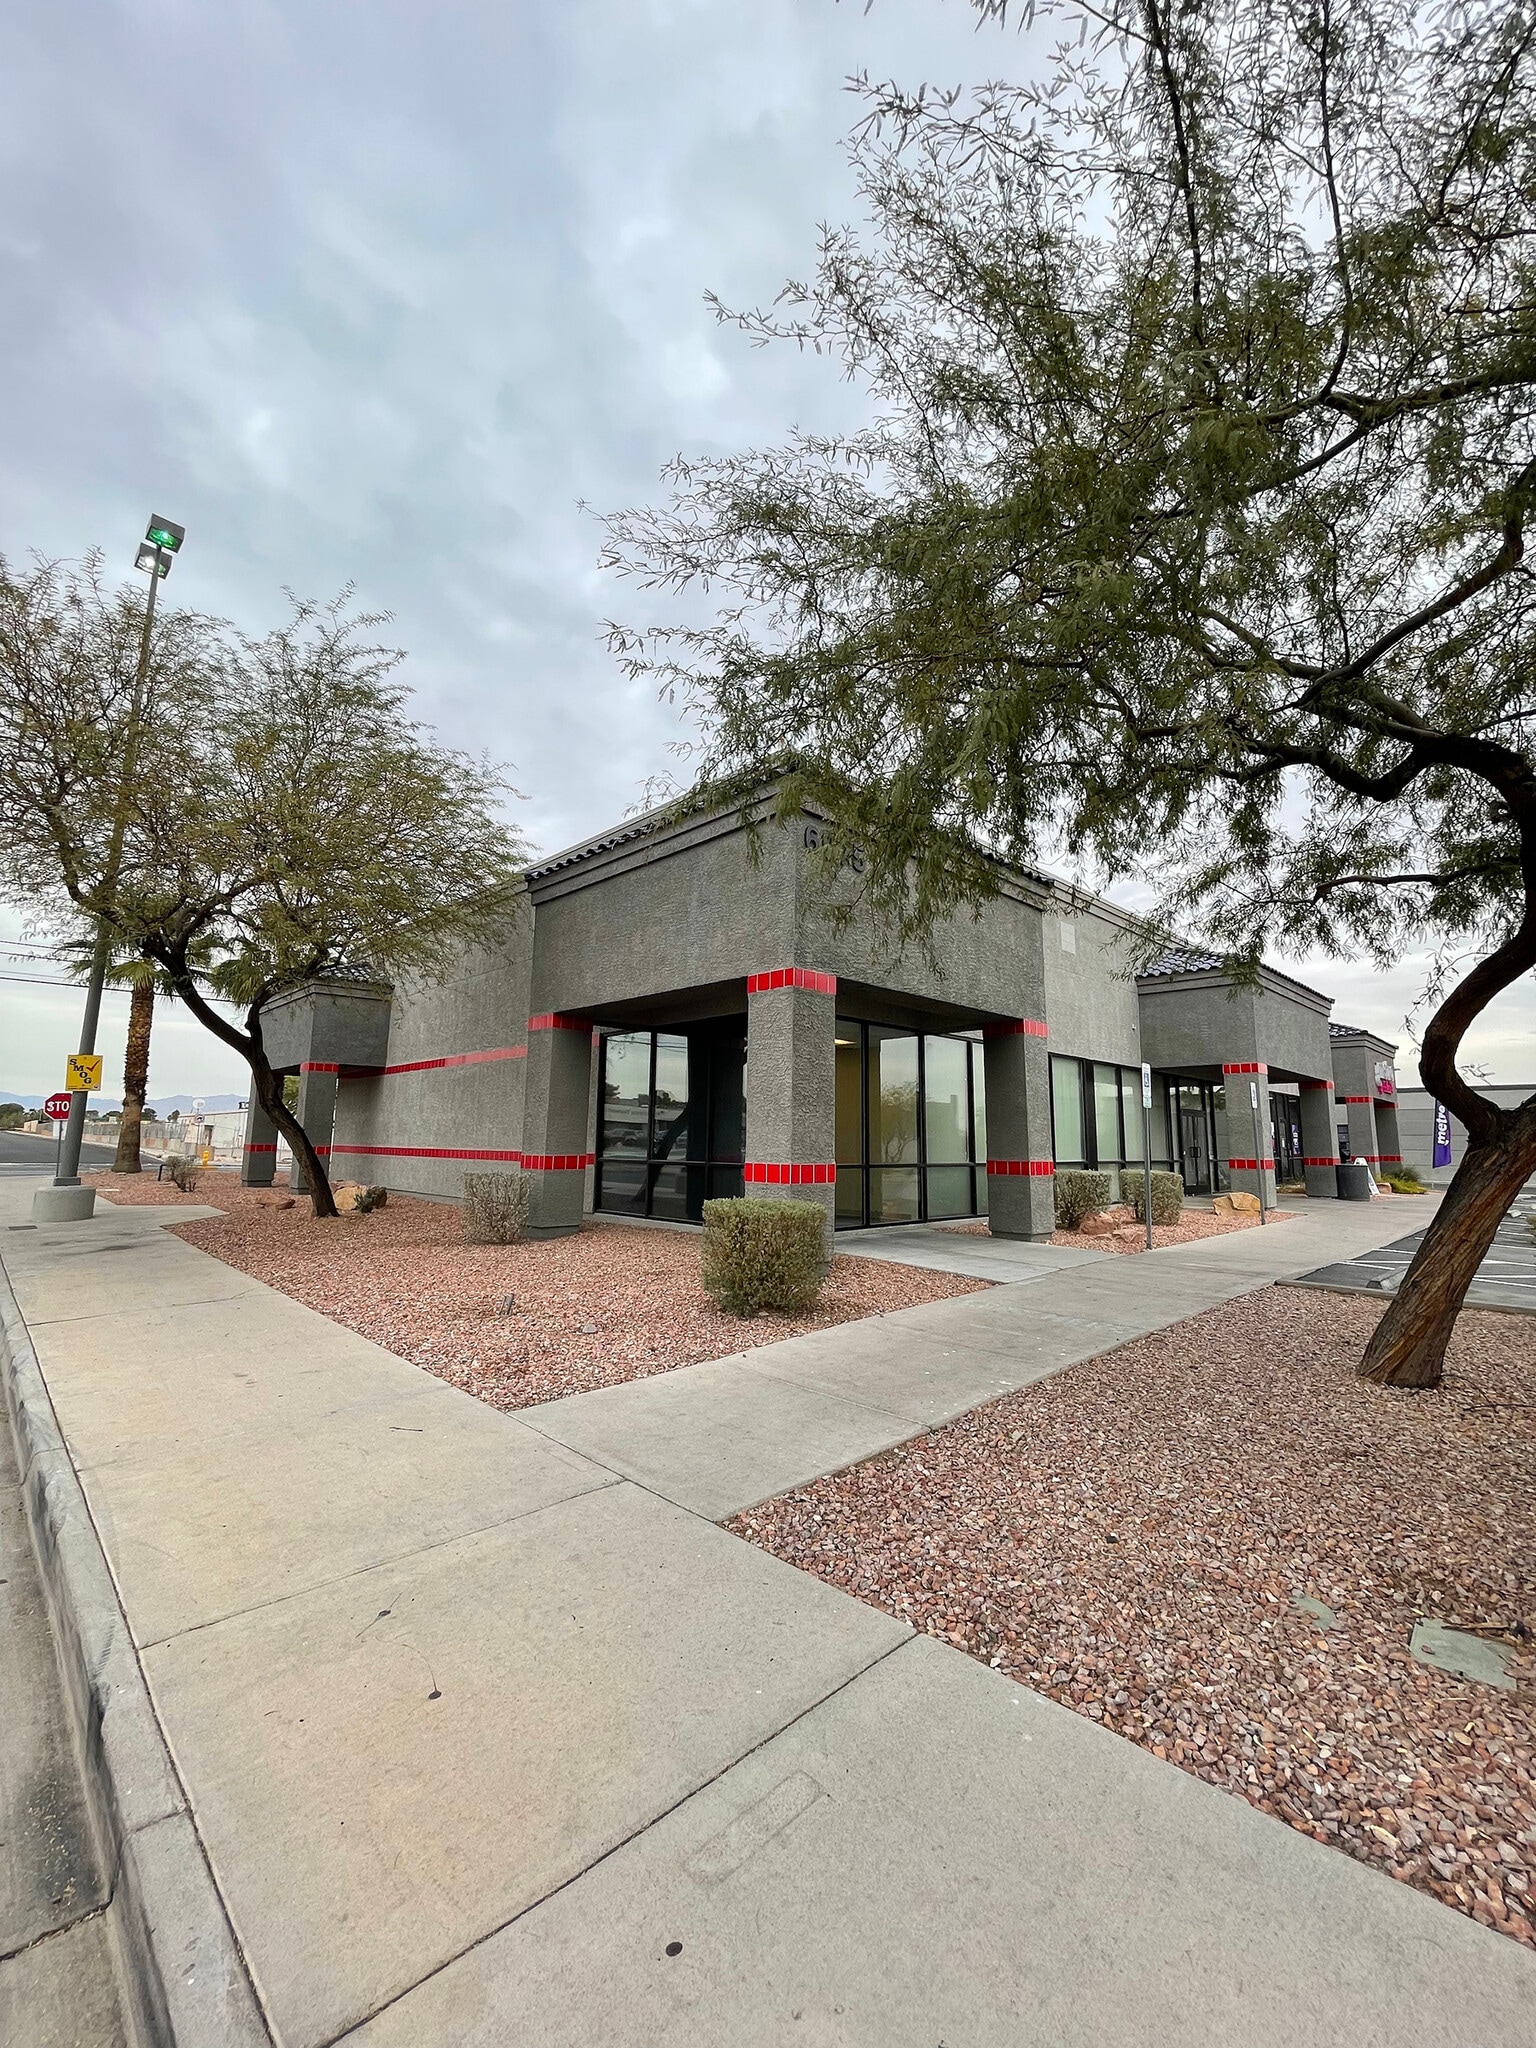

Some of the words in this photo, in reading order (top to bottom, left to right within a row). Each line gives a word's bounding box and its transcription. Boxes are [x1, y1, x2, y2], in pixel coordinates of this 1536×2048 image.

[69, 1058, 92, 1085] SMOG
[46, 1101, 70, 1112] STO
[1436, 1105, 1449, 1146] metro
